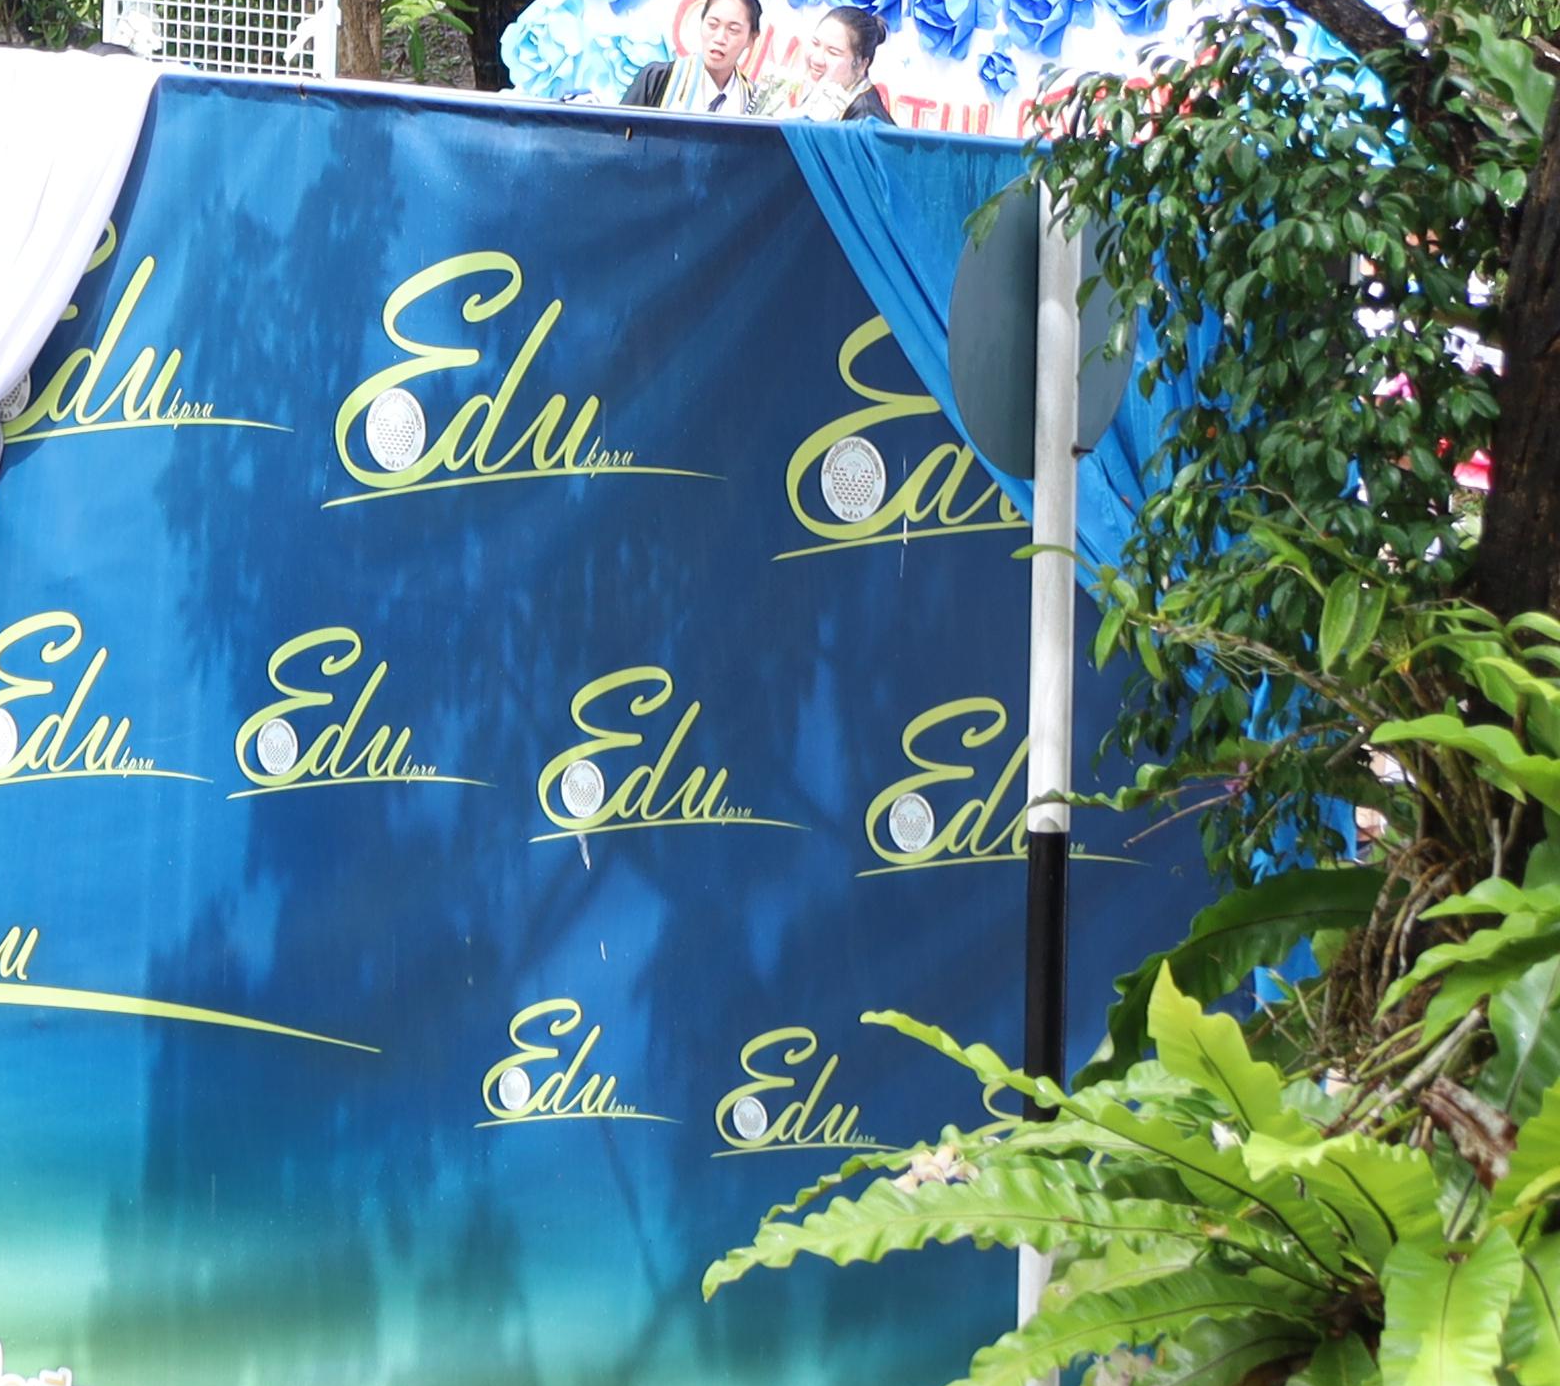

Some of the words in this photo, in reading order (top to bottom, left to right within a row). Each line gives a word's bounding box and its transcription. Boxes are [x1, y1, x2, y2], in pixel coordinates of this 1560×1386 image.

[3, 219, 182, 439] du
[162, 387, 214, 430] kpru
[335, 250, 600, 489] Edu
[579, 435, 635, 478] kpru
[118, 746, 155, 780] kpru
[234, 626, 412, 788] Edu
[400, 753, 438, 784] kpru
[538, 665, 727, 831] Edu
[716, 796, 753, 827] kpru
[481, 997, 617, 1120] Edu
[715, 1025, 860, 1150] Edu
